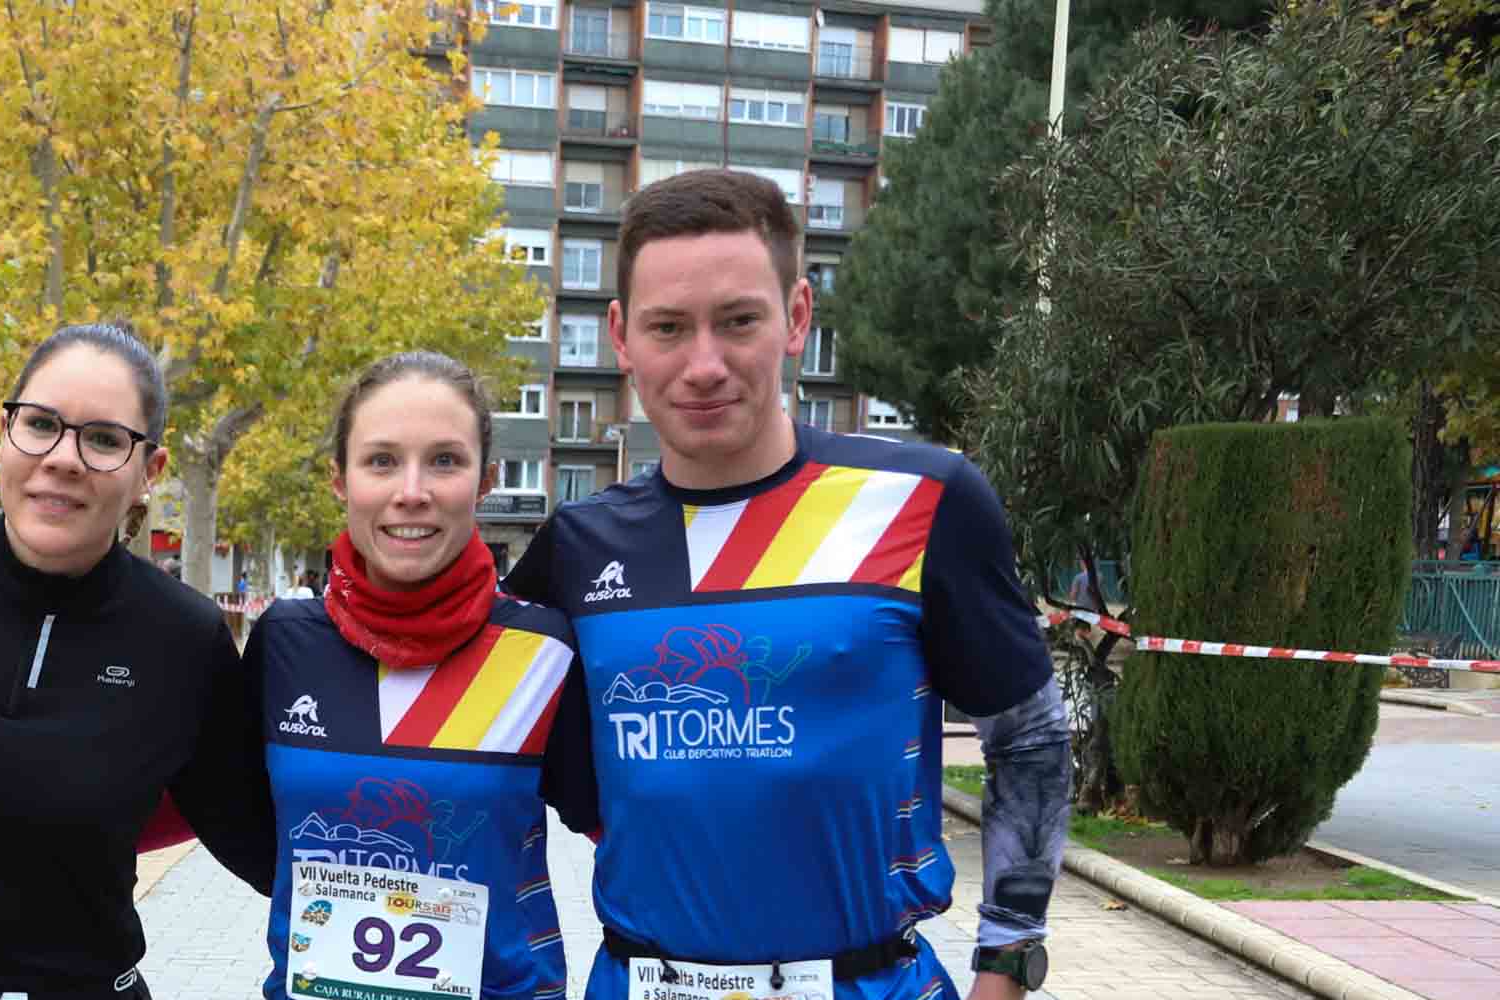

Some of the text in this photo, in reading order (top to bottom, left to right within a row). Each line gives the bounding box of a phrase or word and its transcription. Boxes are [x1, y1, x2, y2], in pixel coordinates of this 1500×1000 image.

[663, 749, 687, 760] CLUB
[688, 749, 742, 760] DEPORTIVO
[299, 866, 419, 893] VII Vuelta Pedestre
[315, 883, 376, 902] Salamanca
[352, 916, 443, 980] 92
[637, 966, 754, 990] VII Velta Pedestre
[313, 984, 339, 997] CAJA
[341, 989, 377, 1000] RURAL
[643, 990, 650, 1000] a
